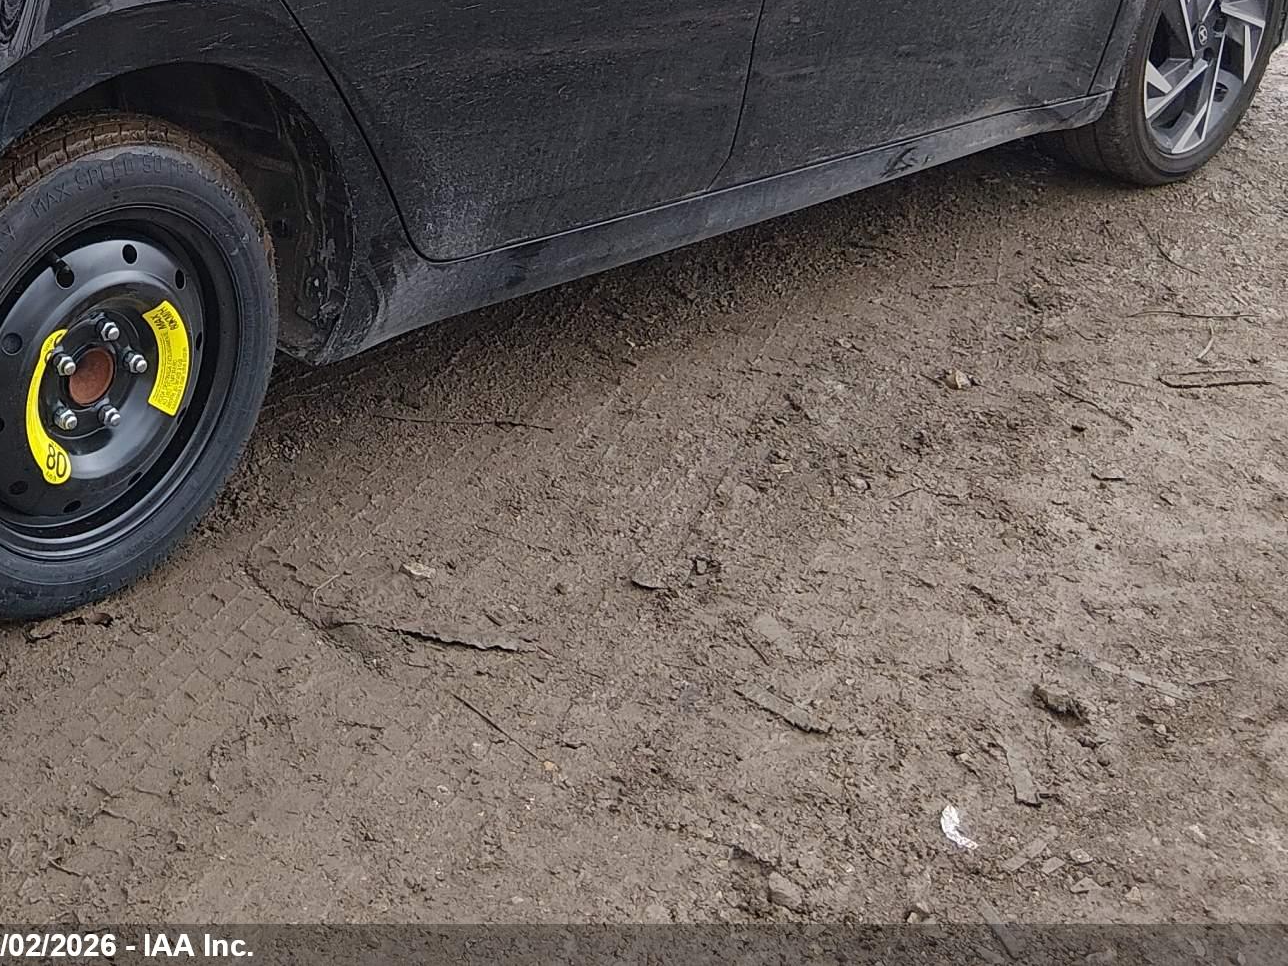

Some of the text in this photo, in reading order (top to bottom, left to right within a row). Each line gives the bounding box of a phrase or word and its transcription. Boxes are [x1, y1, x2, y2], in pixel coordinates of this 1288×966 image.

[29, 183, 73, 219] MAX
[151, 313, 168, 331] MAX
[46, 443, 68, 479] 80
